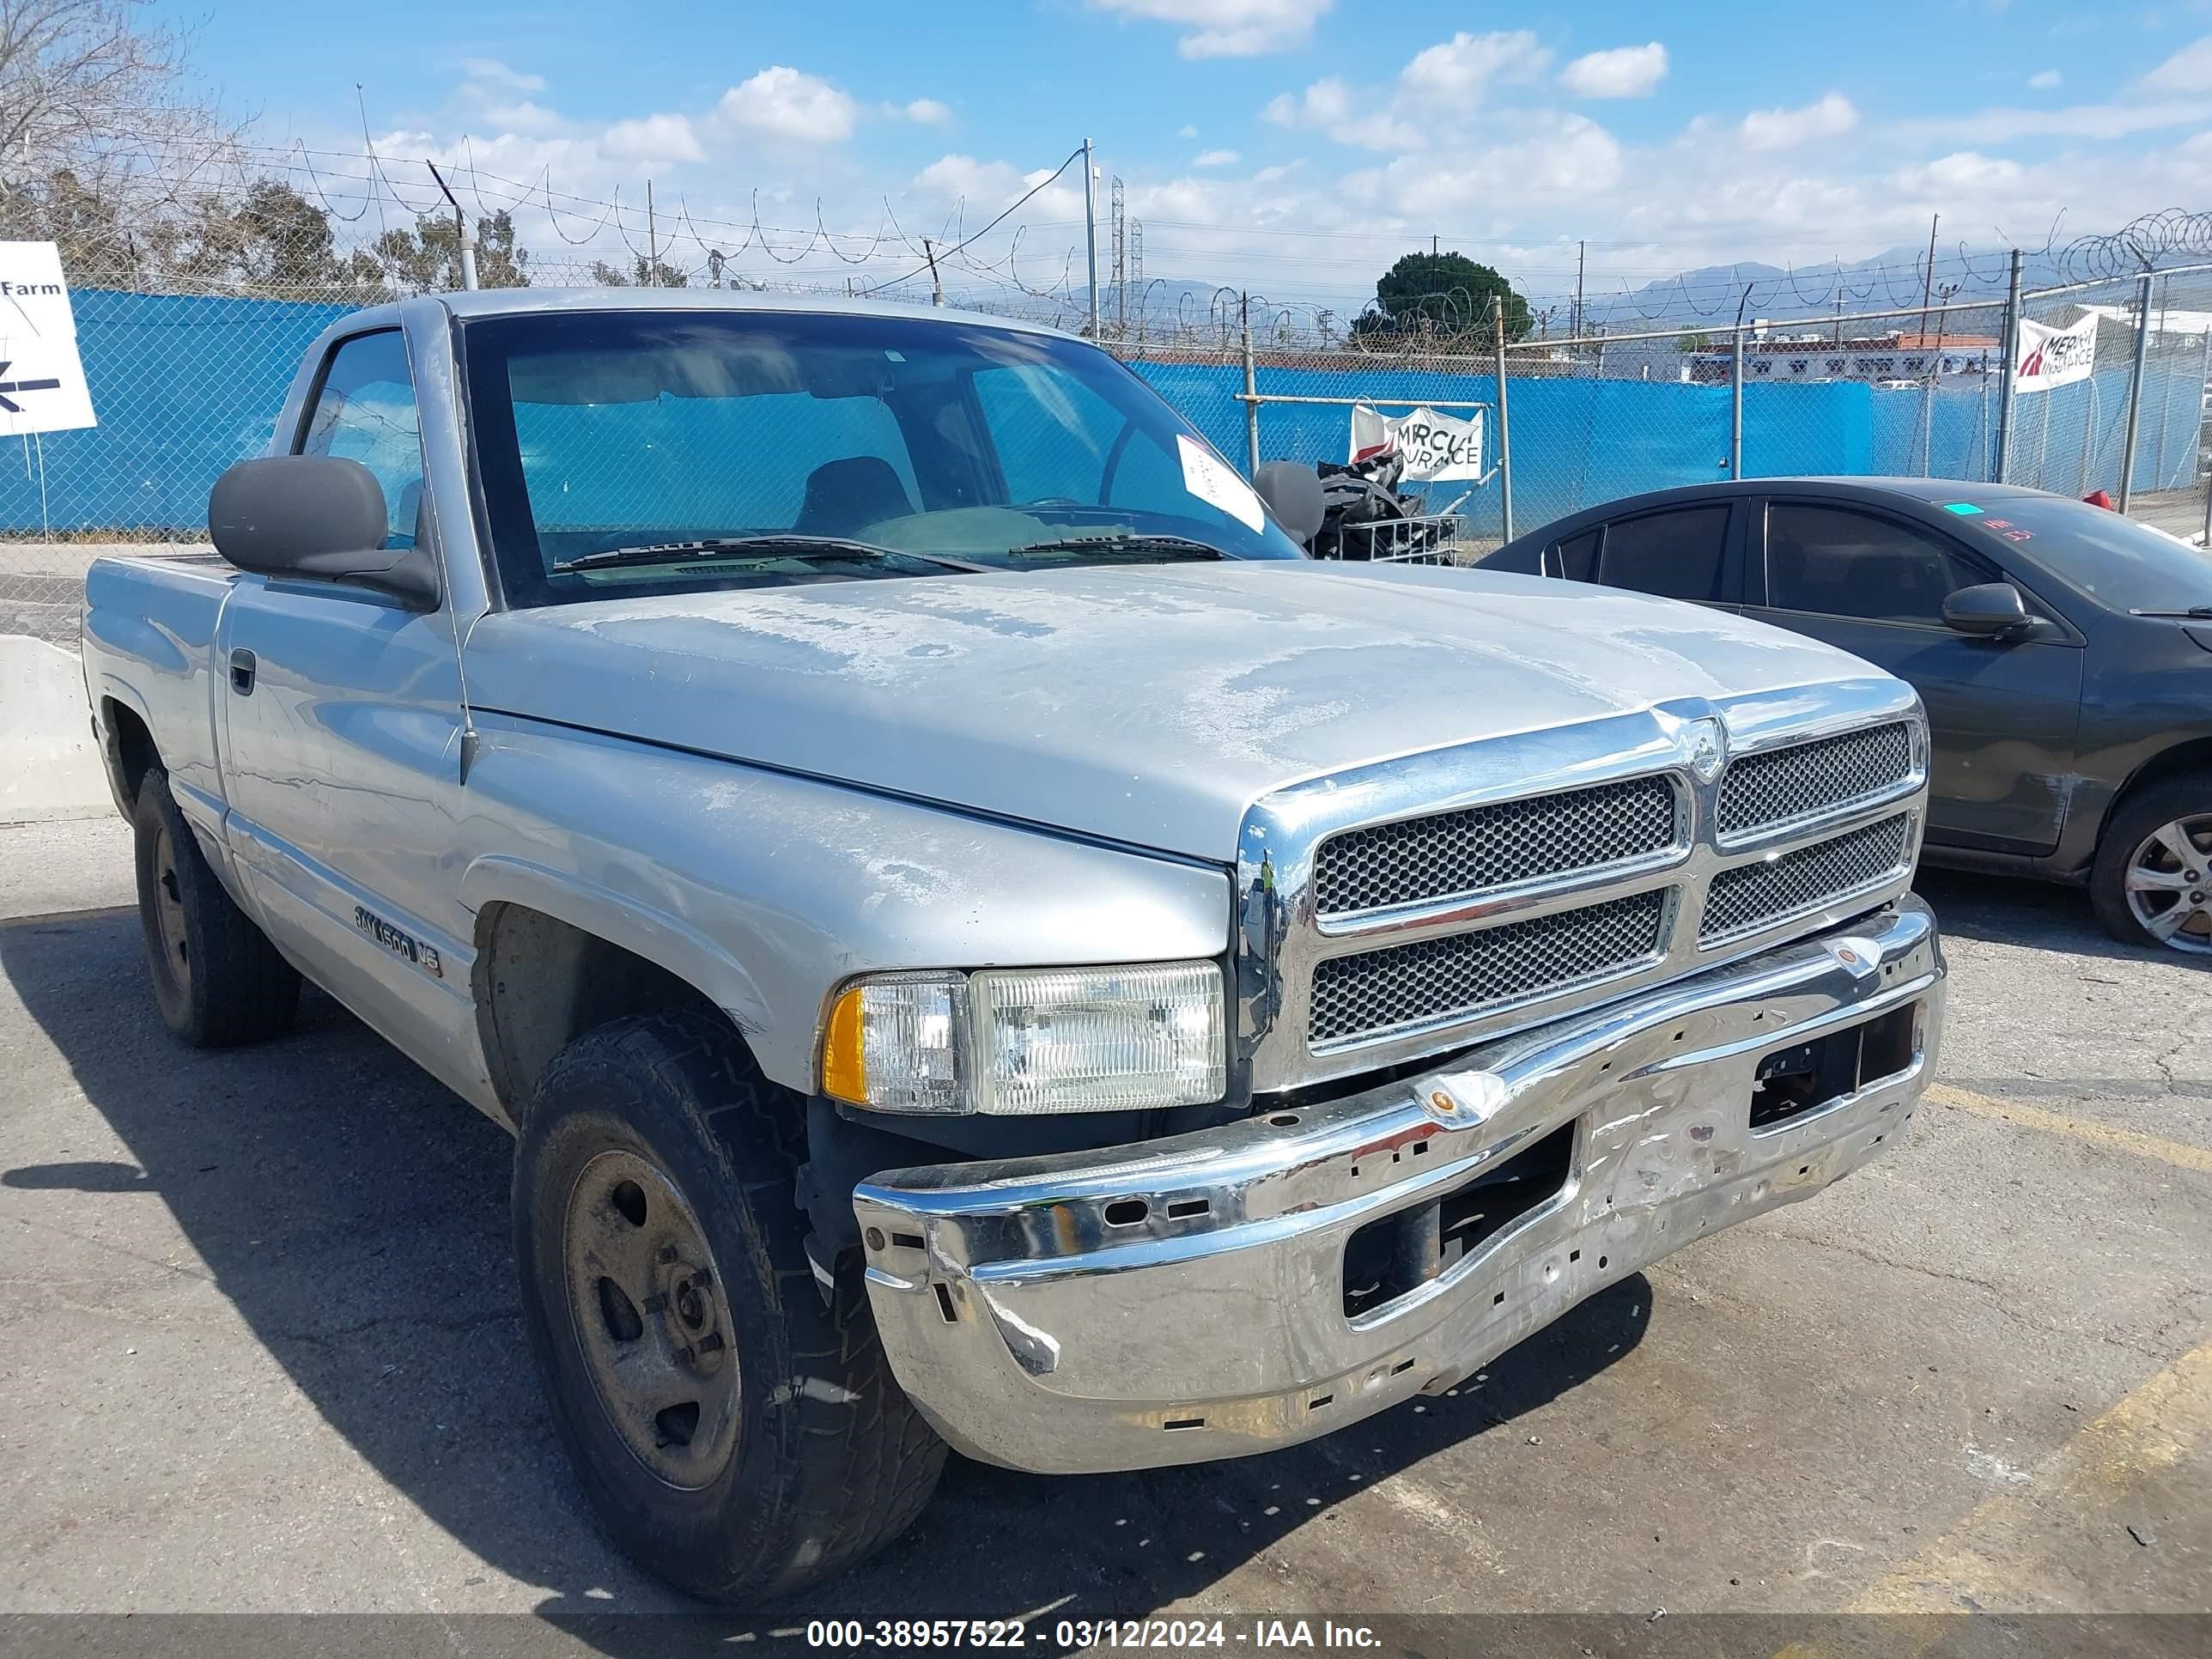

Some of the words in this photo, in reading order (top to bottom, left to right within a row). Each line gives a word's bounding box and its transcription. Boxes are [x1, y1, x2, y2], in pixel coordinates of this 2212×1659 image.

[1, 281, 61, 296] Farm
[354, 907, 380, 942] RAM
[377, 923, 416, 962] 1500
